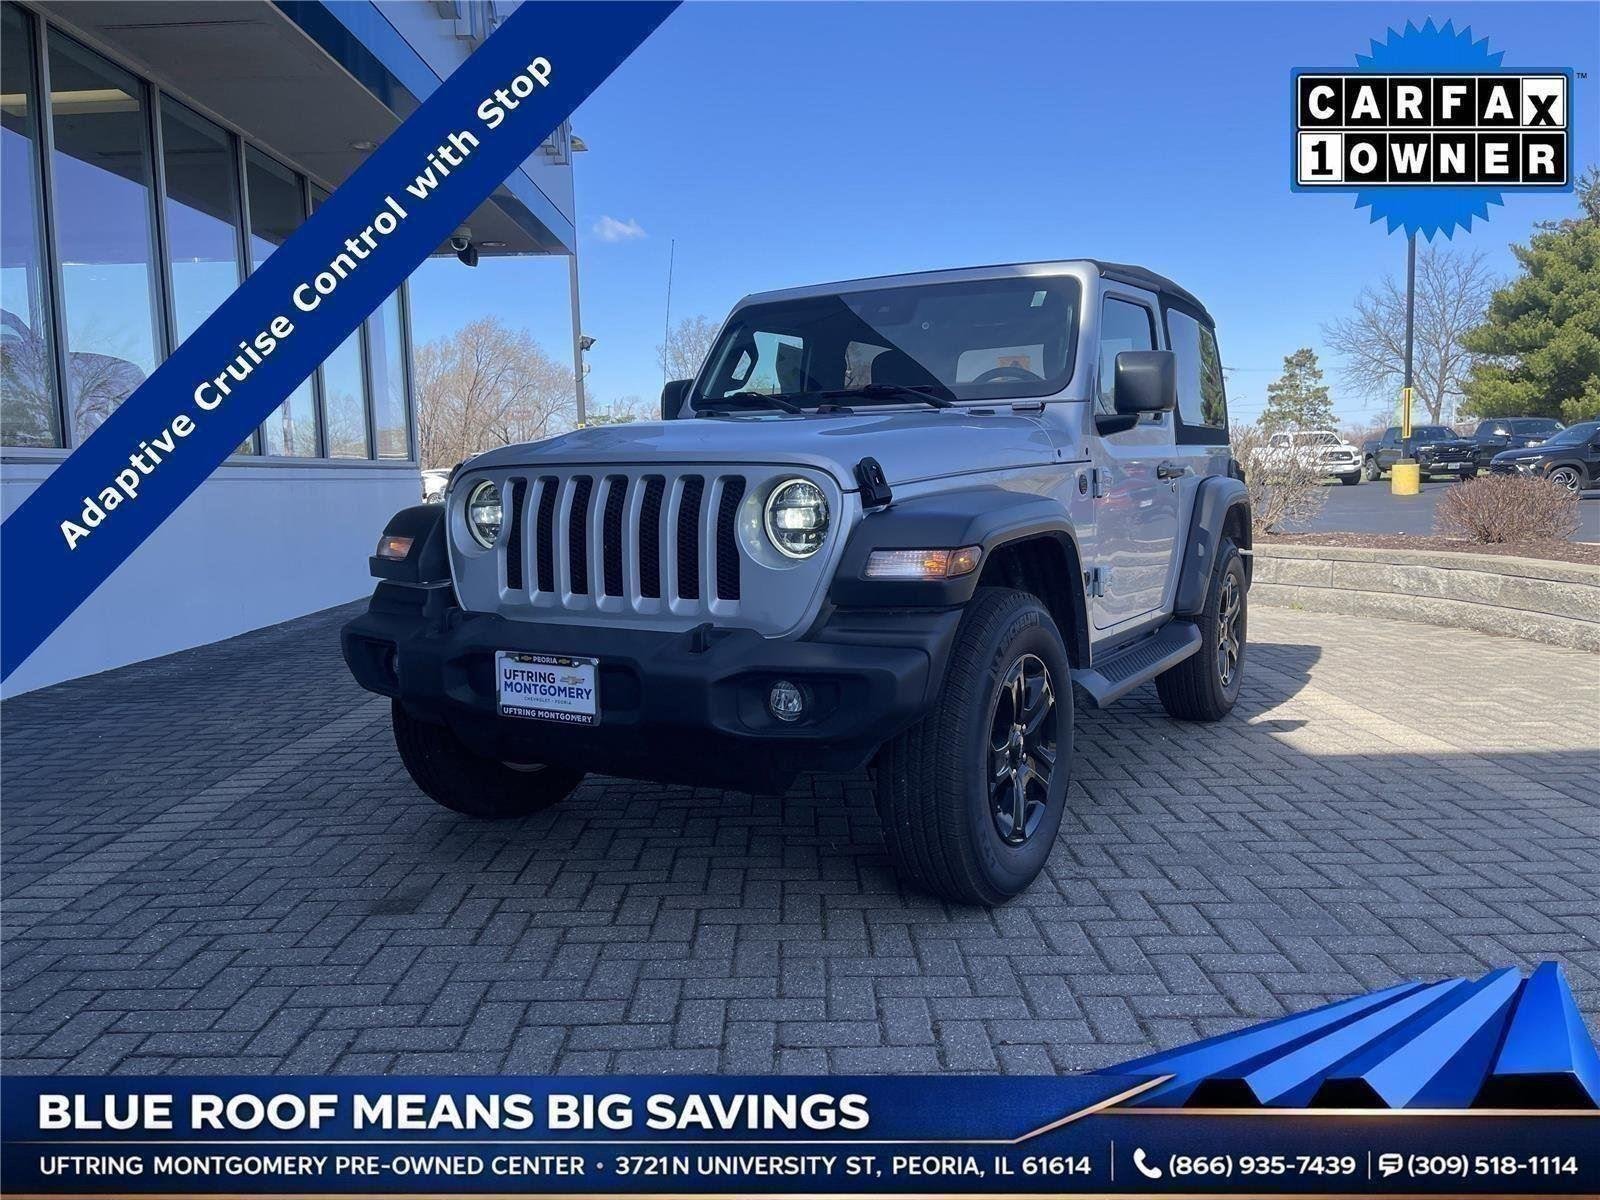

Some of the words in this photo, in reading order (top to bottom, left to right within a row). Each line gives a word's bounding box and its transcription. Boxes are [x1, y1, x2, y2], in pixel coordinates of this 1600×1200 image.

[533, 655, 558, 665] PEORIA
[503, 668, 556, 684] UFTRING
[503, 680, 593, 700] MONTGOMERY
[503, 706, 537, 717] UFTRING
[537, 711, 593, 724] MONTGOMERY
